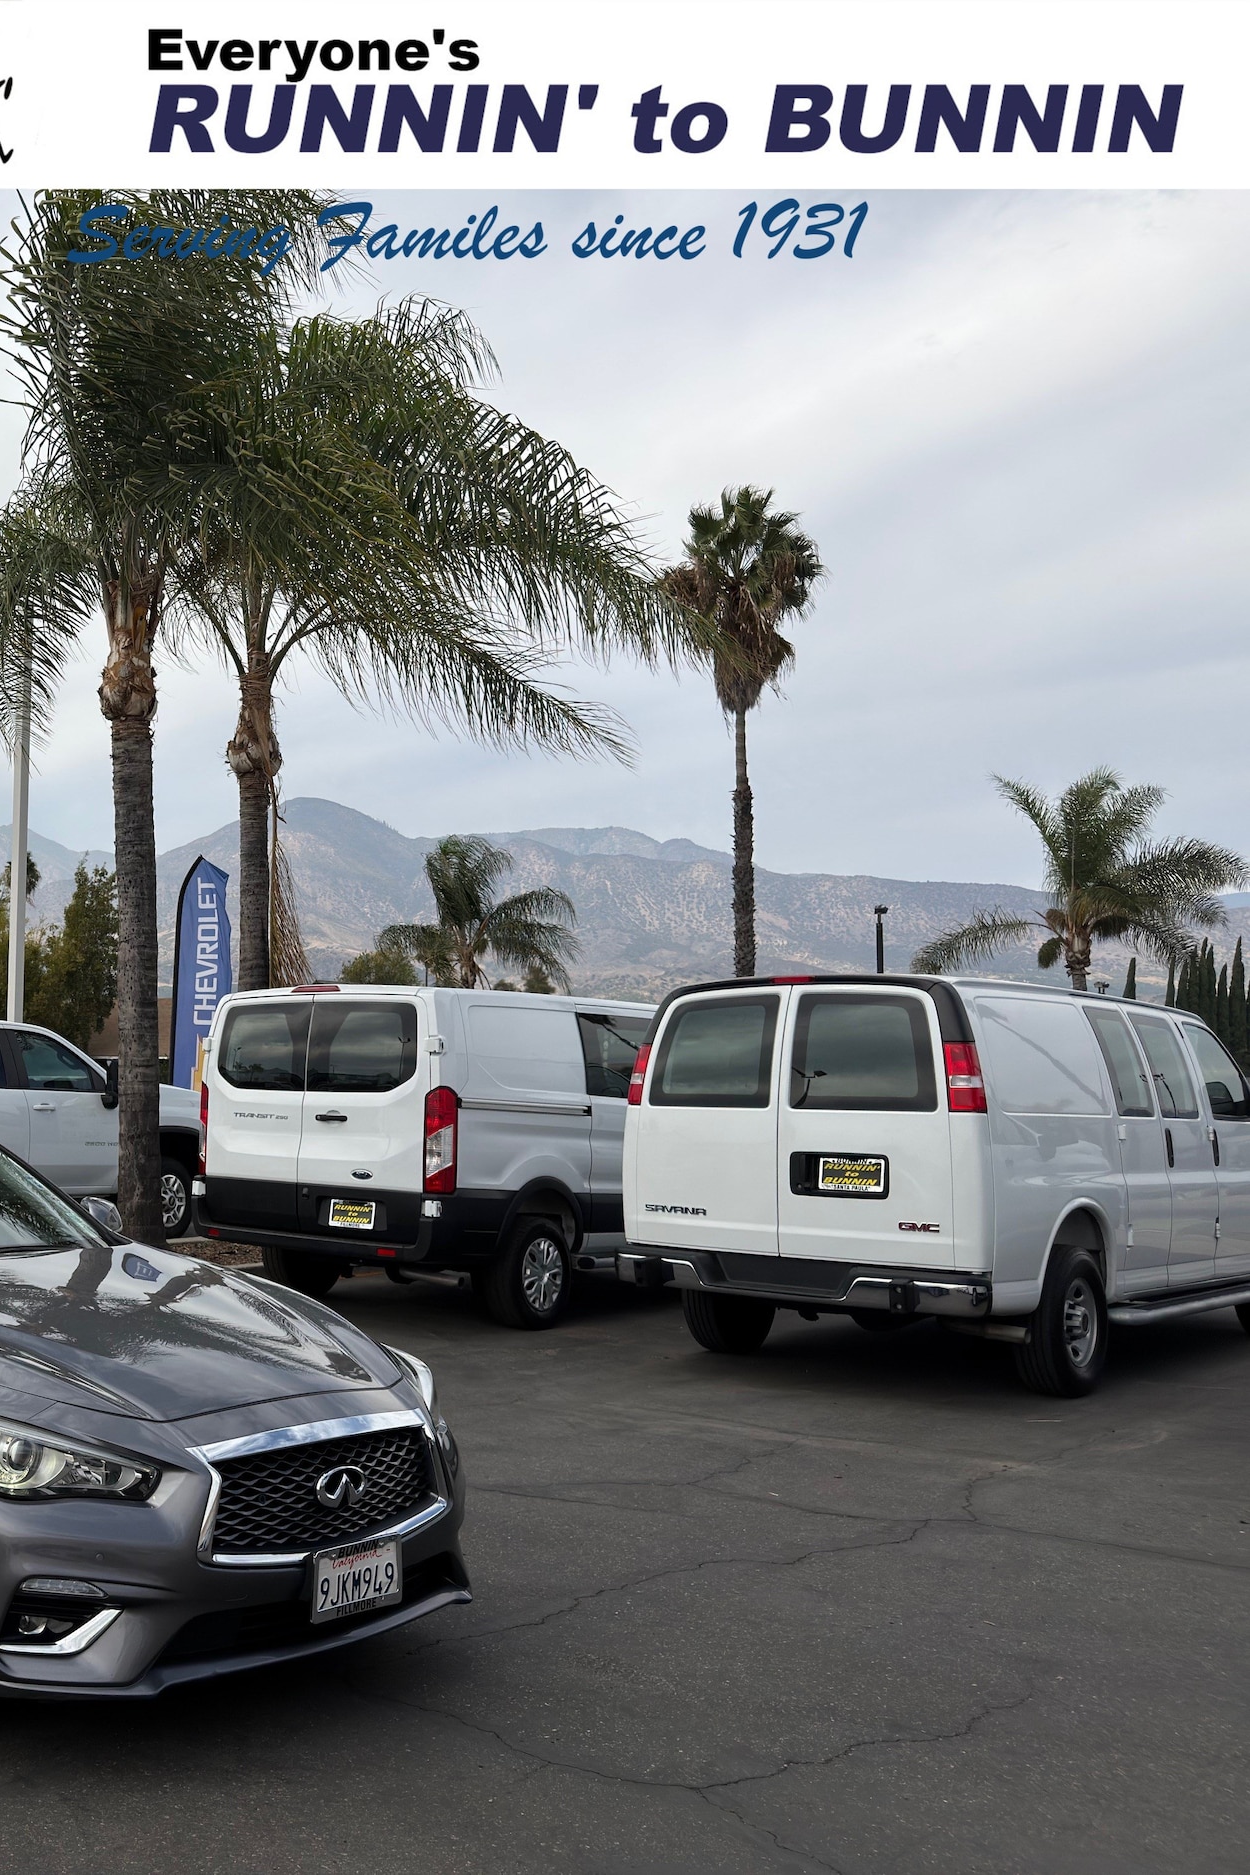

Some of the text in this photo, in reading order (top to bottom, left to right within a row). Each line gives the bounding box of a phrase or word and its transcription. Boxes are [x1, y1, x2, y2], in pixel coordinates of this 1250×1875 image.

[192, 877, 220, 1026] CHEVROLET
[233, 1111, 275, 1120] TRANSIT
[823, 1176, 878, 1186] BUNNIN
[645, 1204, 707, 1216] SAVANA
[333, 1215, 370, 1224] BUNNIN
[898, 1220, 940, 1233] GMC
[338, 1539, 379, 1558] BUNNIN
[318, 1562, 395, 1611] 9JKM949
[336, 1600, 376, 1616] FILLMORE
